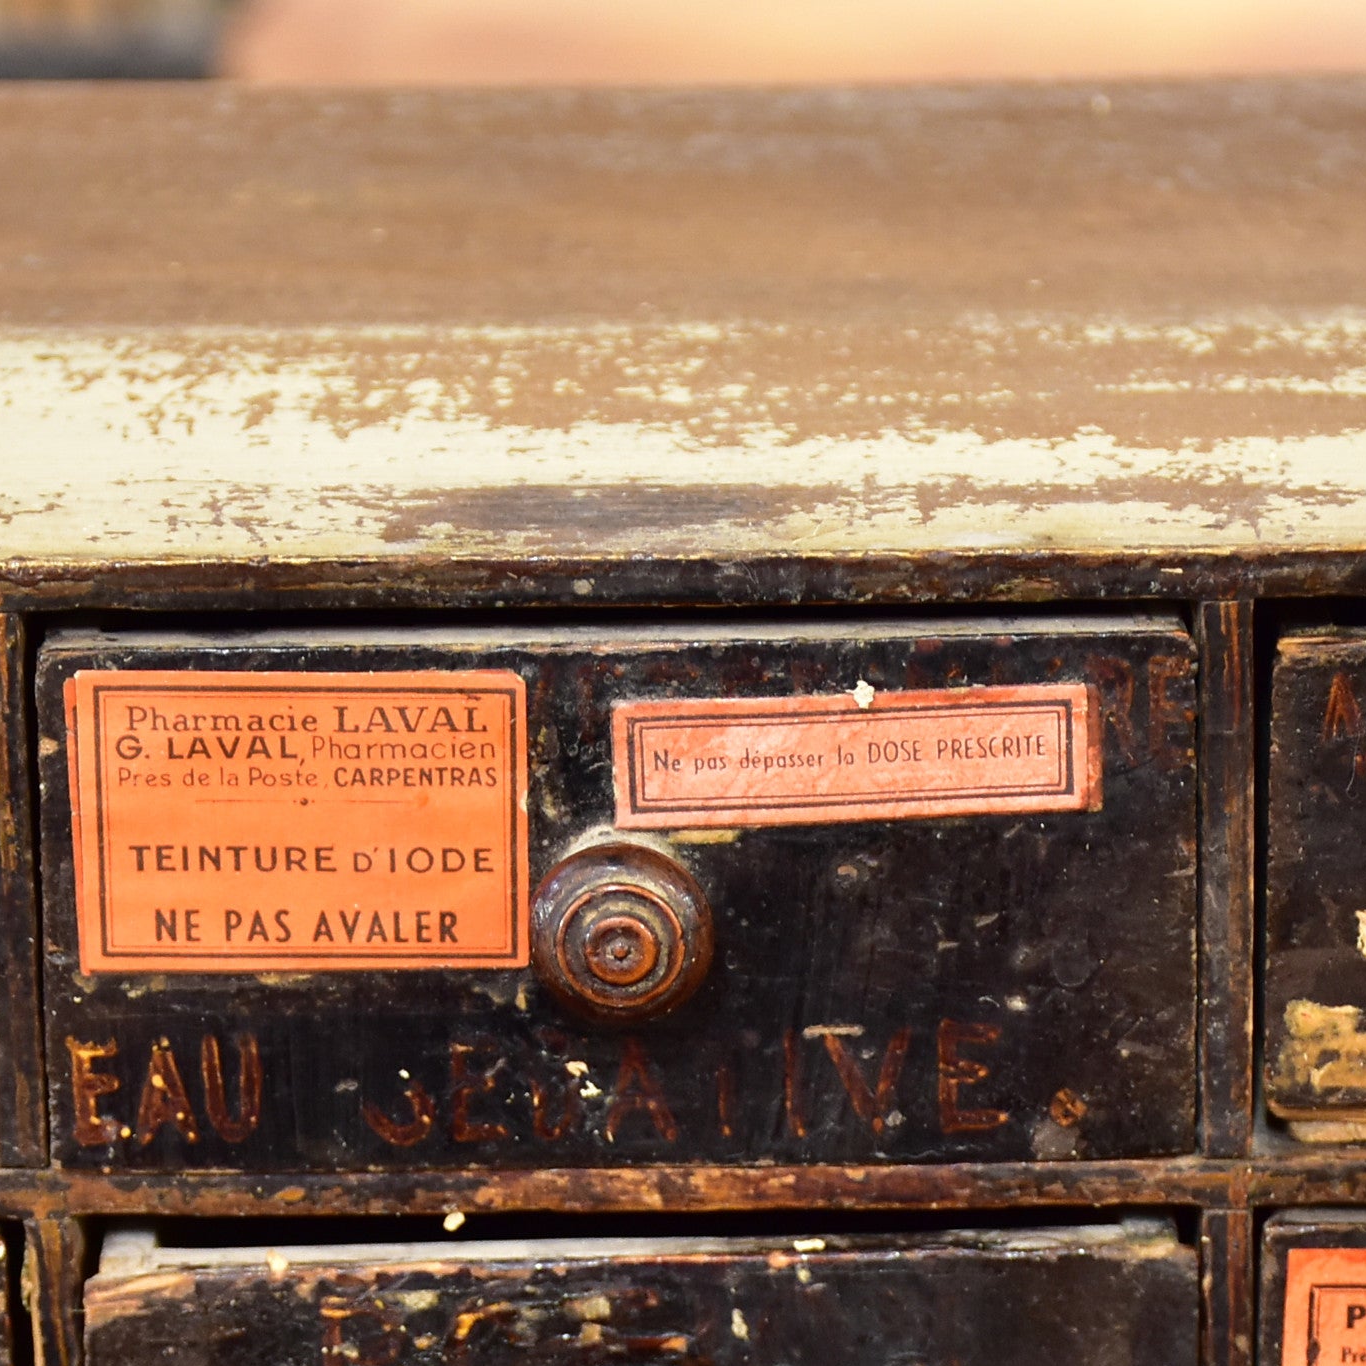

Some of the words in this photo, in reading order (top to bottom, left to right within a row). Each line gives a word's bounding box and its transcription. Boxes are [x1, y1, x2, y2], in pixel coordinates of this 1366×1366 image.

[125, 705, 318, 732] Pharmacie
[333, 705, 488, 733] LAVAL
[115, 735, 150, 760] G.
[167, 735, 305, 767] LAVAL,
[312, 736, 496, 760] Pharmacien
[653, 748, 681, 773] Ne
[693, 754, 728, 776] pas
[739, 748, 824, 773] dépasser
[867, 739, 922, 764] DOSE
[937, 734, 1046, 760] PRESCRITE
[182, 767, 211, 787] de
[219, 766, 239, 787] la
[333, 766, 498, 788] CARPENTRAS
[129, 845, 337, 873] TEINTURE
[153, 908, 201, 942] NE
[224, 908, 293, 943] PAS
[312, 909, 460, 943] AVALER
[65, 1032, 265, 1149] EAU
